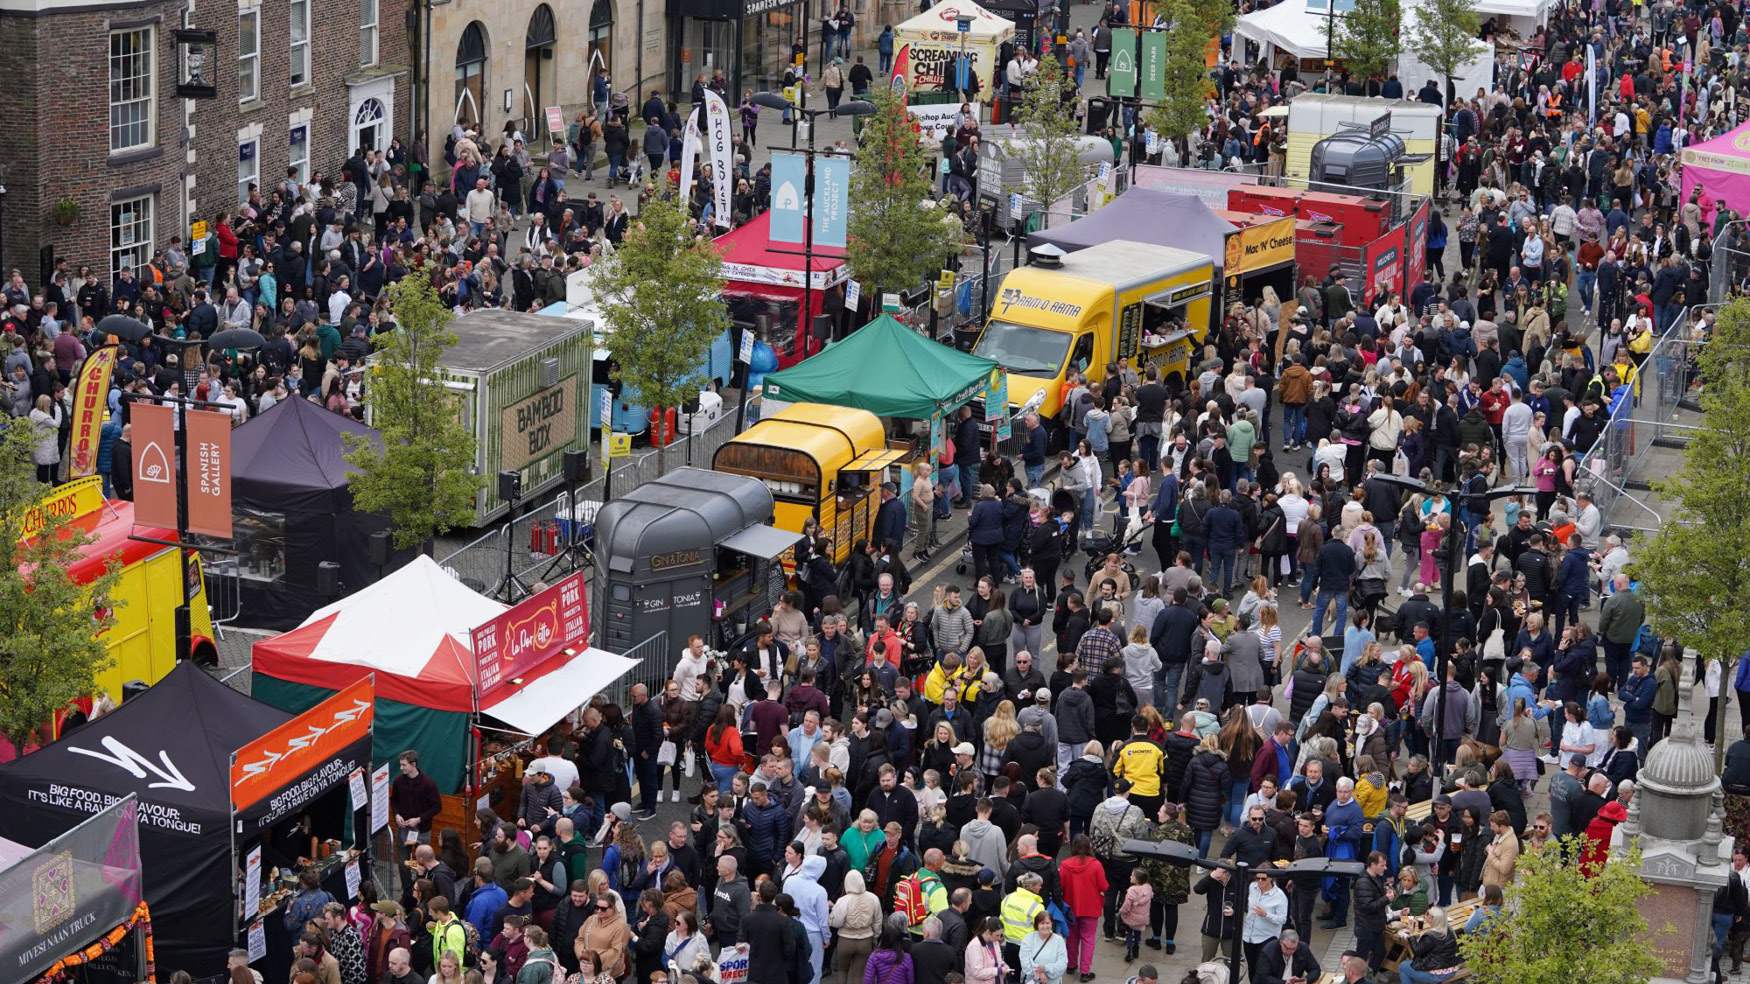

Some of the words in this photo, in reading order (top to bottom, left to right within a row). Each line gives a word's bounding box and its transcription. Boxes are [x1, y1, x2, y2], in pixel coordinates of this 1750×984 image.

[910, 48, 978, 62] SCREAMING
[919, 112, 940, 121] ishop
[715, 118, 724, 152] HOG
[824, 167, 832, 214] AUCKLAND
[830, 182, 839, 220] PROJECT
[822, 217, 830, 233] THE
[1244, 244, 1259, 256] Mac
[1270, 236, 1292, 249] Cheese
[517, 386, 563, 433] BAMBOO
[956, 390, 968, 403] Craft
[76, 367, 102, 470] CHURROS
[530, 422, 550, 456] BOX
[200, 442, 210, 494] SPANISH
[210, 442, 220, 496] GALLERY
[562, 586, 580, 608] PORK
[650, 600, 664, 608] GIN
[673, 594, 696, 604] TONIA
[478, 632, 497, 654] PORK
[50, 784, 69, 798] BIG
[70, 788, 102, 804] FOOD.
[137, 802, 180, 820] AVOUR:
[270, 794, 282, 810] BIG
[282, 784, 301, 804] FOOD.
[300, 777, 313, 792] BIG
[272, 805, 287, 822] LIKE
[293, 790, 310, 808] RAVE
[328, 760, 356, 786] TONGUE!
[28, 789, 48, 803] IT'S
[50, 794, 72, 808] LIKE
[74, 800, 83, 811] A
[150, 814, 202, 834] TONGUE!
[18, 942, 47, 967] MIVESI
[46, 930, 68, 950] NAAN
[68, 912, 97, 935] TRUCK
[720, 959, 748, 972] SPOR
